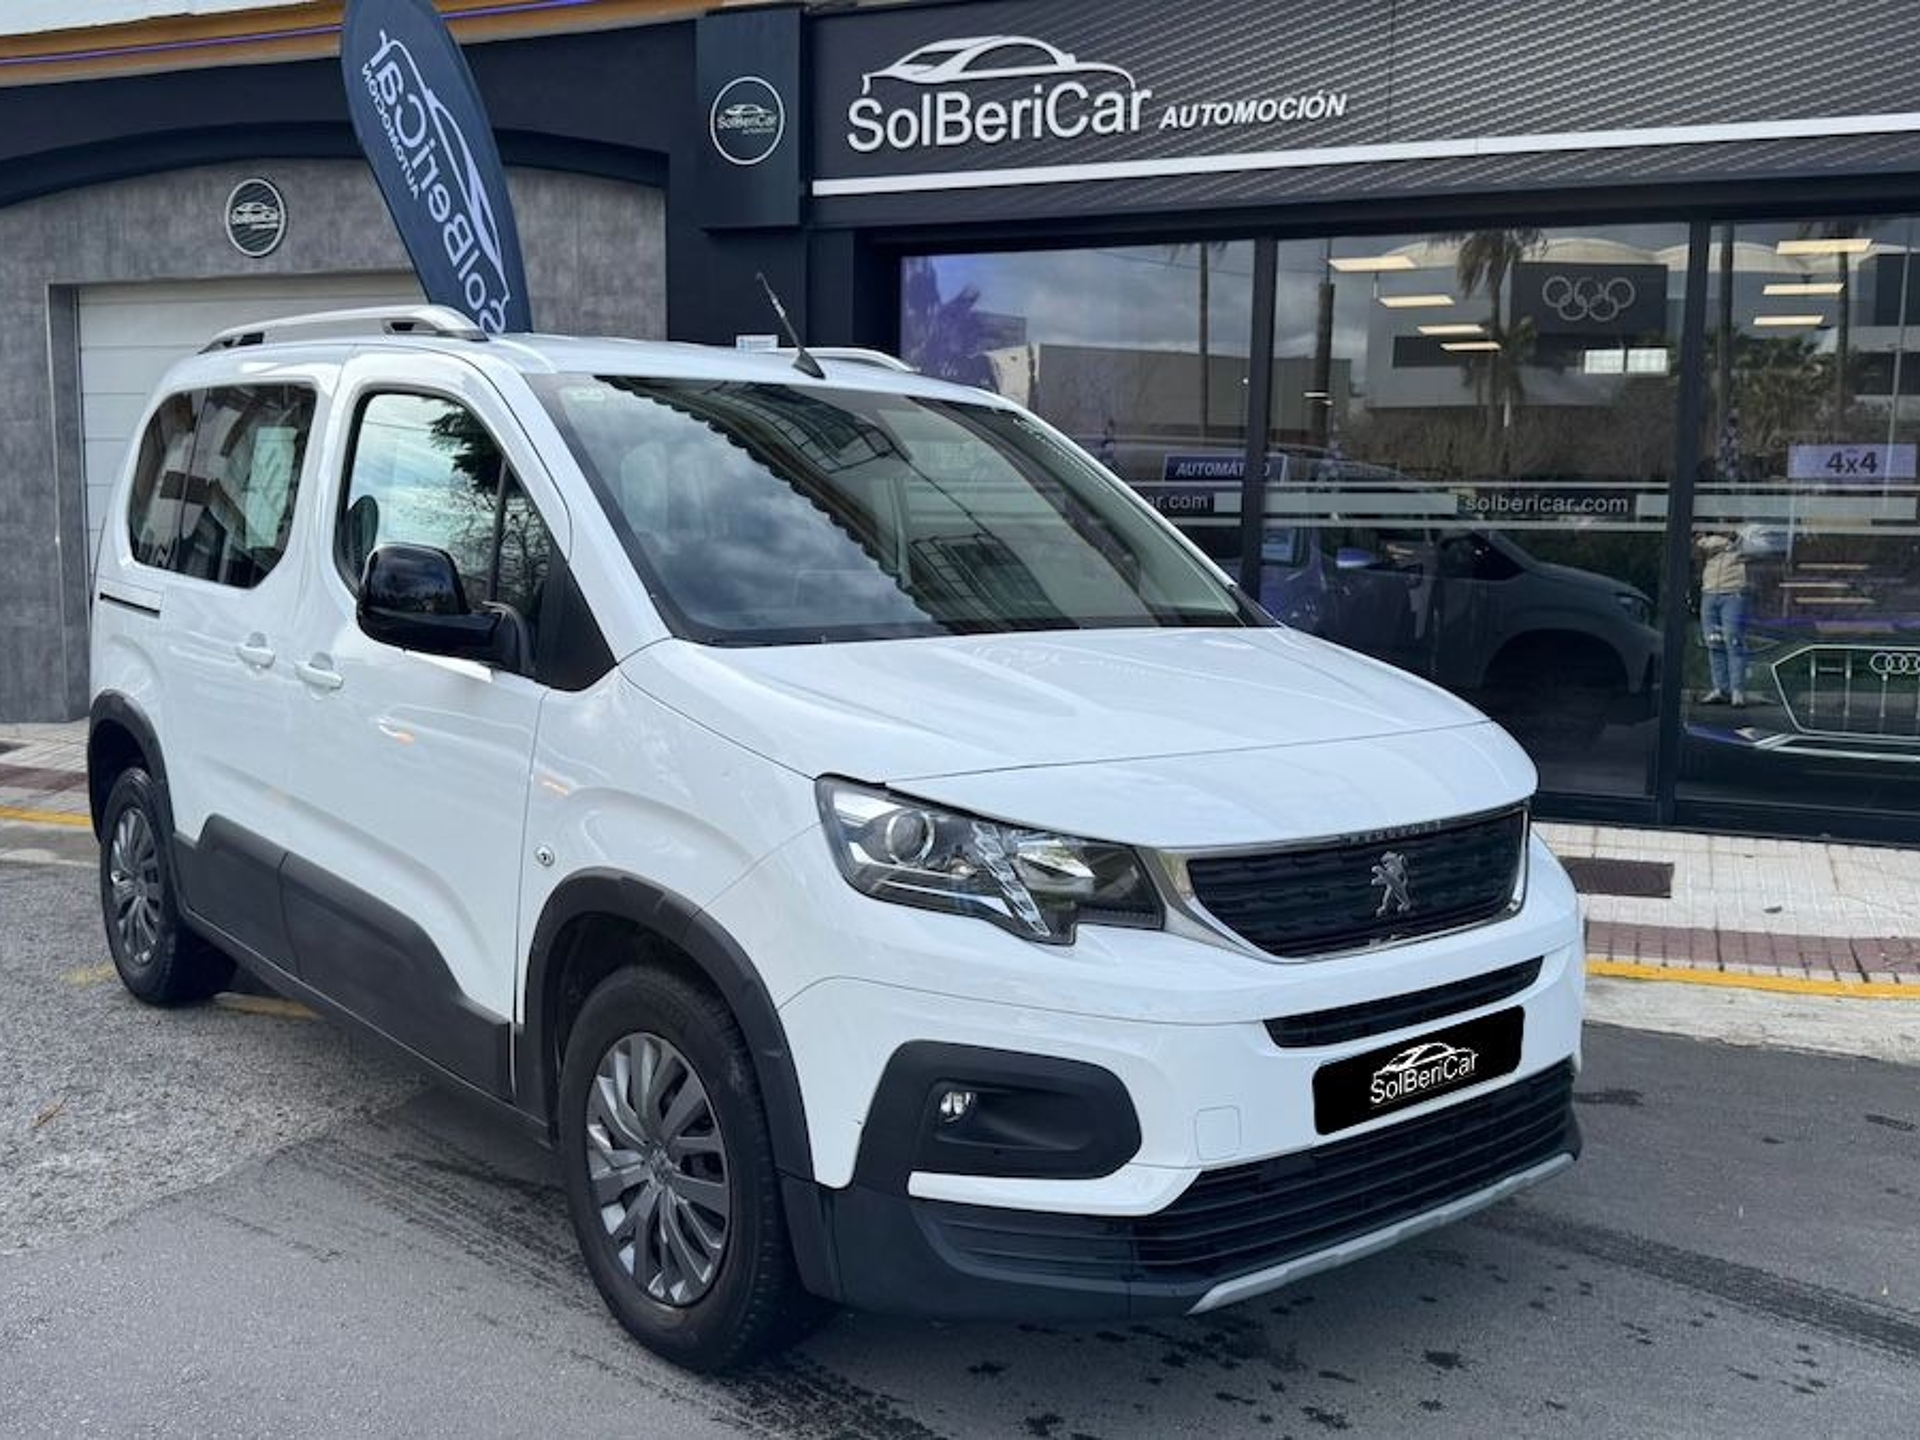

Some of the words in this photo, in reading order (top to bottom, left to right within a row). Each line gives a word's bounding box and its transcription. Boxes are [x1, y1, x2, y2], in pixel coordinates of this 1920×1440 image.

[847, 82, 1153, 152] SolBeriCar
[1159, 90, 1347, 130] AUTOMOCIÓN
[1826, 451, 1878, 474] 4x4
[1465, 494, 1628, 513] solbericar.com
